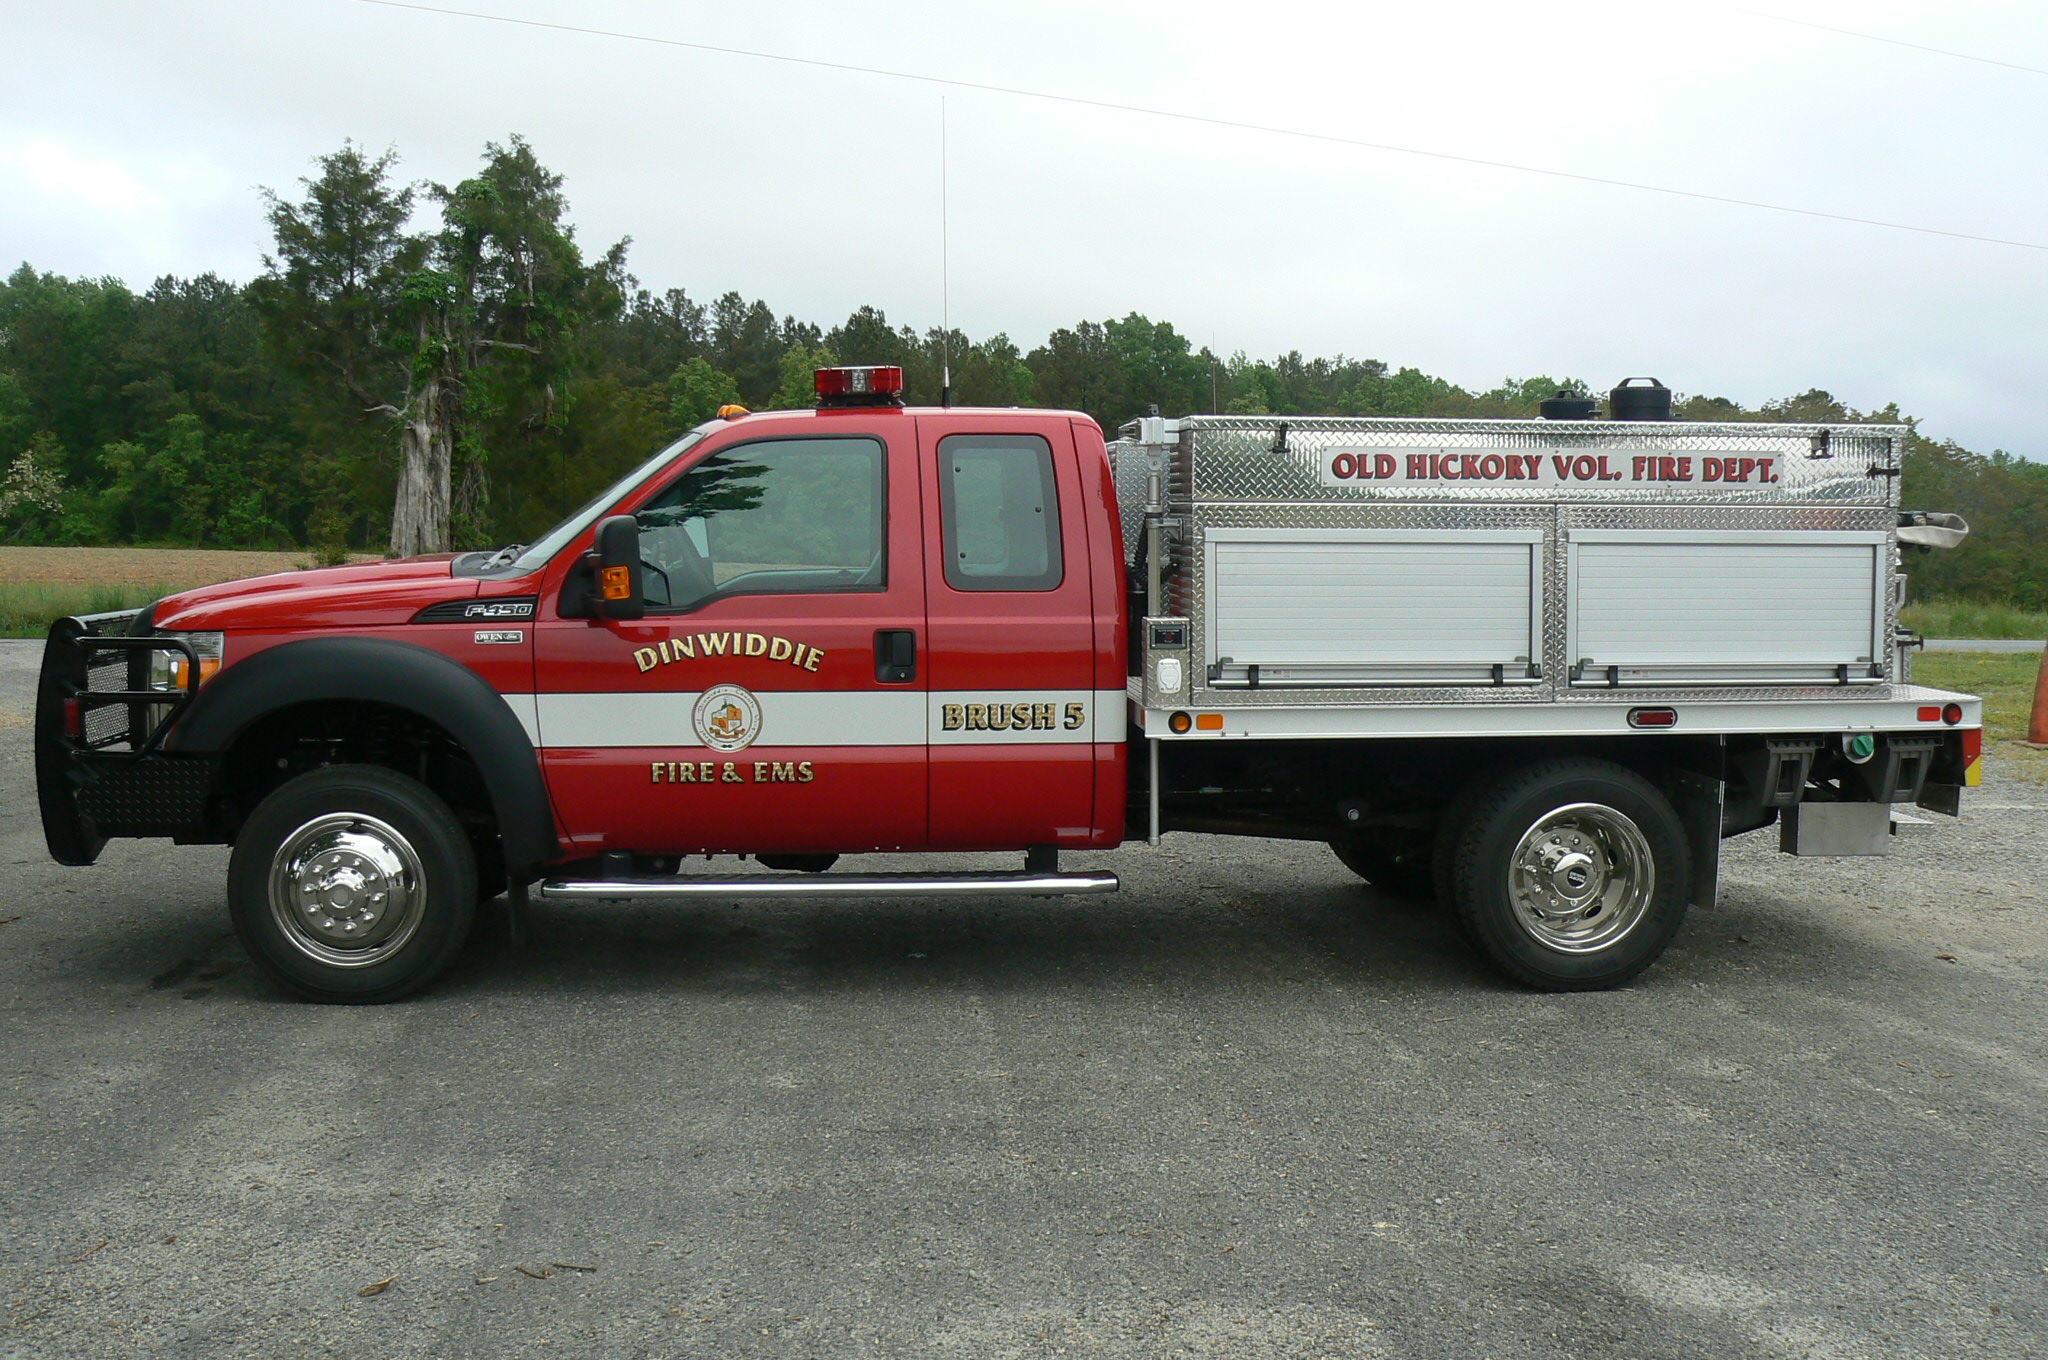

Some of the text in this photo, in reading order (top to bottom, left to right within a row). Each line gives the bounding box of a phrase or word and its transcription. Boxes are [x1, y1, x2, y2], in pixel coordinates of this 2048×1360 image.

[1331, 452, 1779, 483] OLD HICKORY VOL. FIRE DEPT.
[465, 604, 533, 617] F-450
[632, 631, 825, 673] DINWIDDIE
[942, 703, 1085, 731] BRUSH 5
[651, 761, 815, 783] FIRE & EMS
